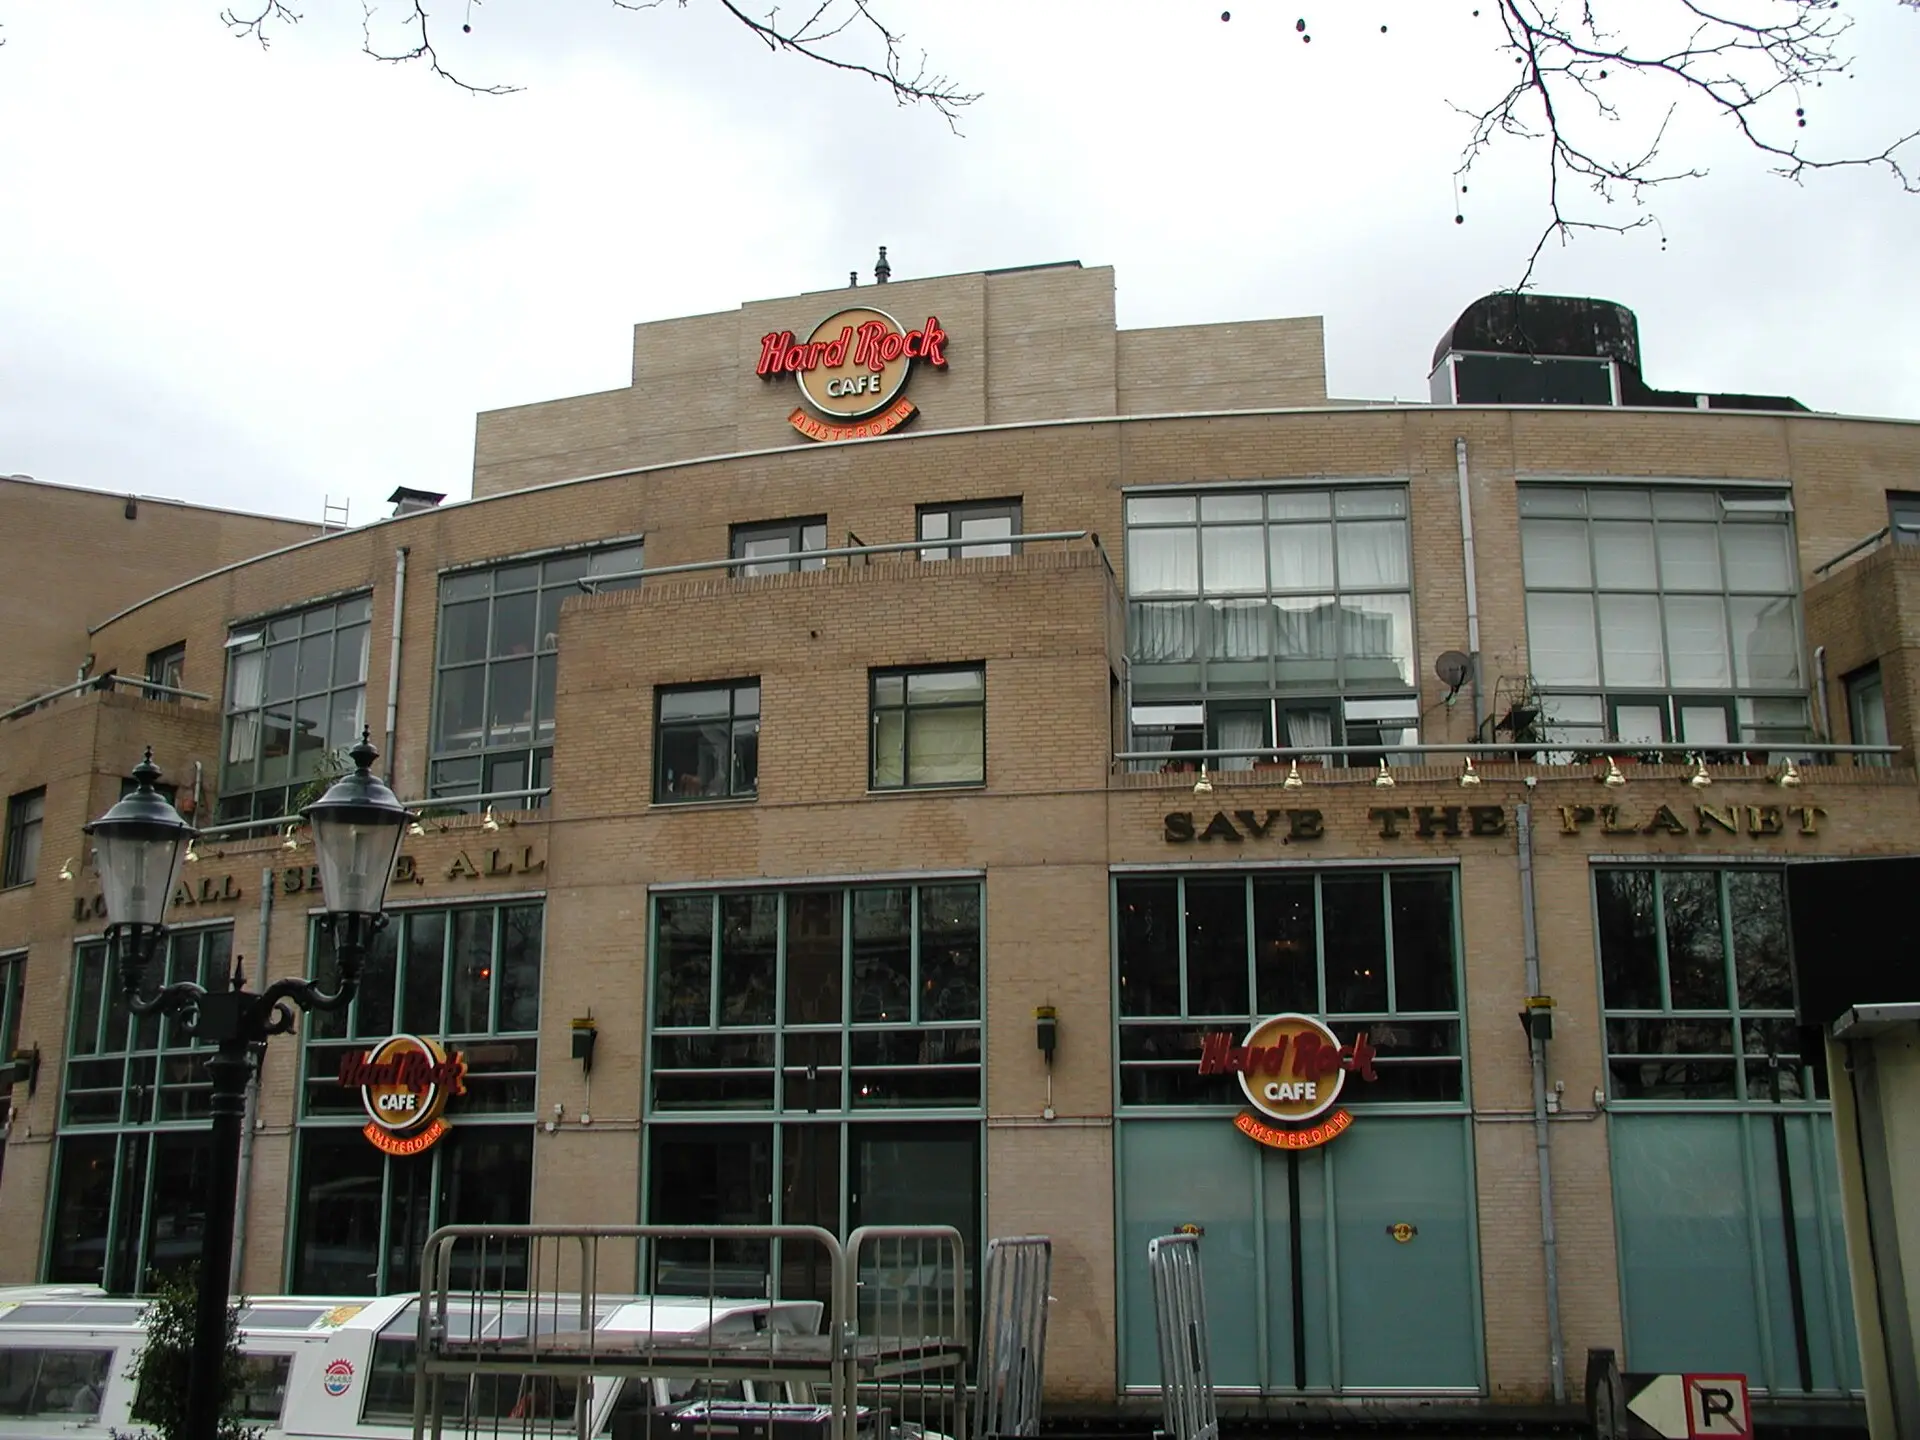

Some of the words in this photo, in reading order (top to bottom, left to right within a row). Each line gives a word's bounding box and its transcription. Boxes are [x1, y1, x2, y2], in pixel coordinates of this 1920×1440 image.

[756, 327, 853, 377] Hard
[854, 316, 948, 373] Rock
[826, 374, 881, 398] CAFE
[793, 402, 913, 441] AMSTERDAM
[1164, 808, 1324, 842] SAVE
[1368, 806, 1506, 838] THE
[1558, 804, 1829, 838] PLANET
[171, 874, 241, 908] ALL
[447, 845, 546, 880] ALL
[338, 1051, 403, 1088] Hard
[399, 1050, 467, 1094] Rock
[1198, 1032, 1289, 1076] Hard
[1291, 1031, 1378, 1082] Rock
[378, 1094, 416, 1111] CAFE
[1263, 1082, 1317, 1101] CAFE
[366, 1122, 443, 1153] AMSTERDAM
[1236, 1110, 1349, 1147] AMSTERDAM
[1701, 1388, 1734, 1428] P
